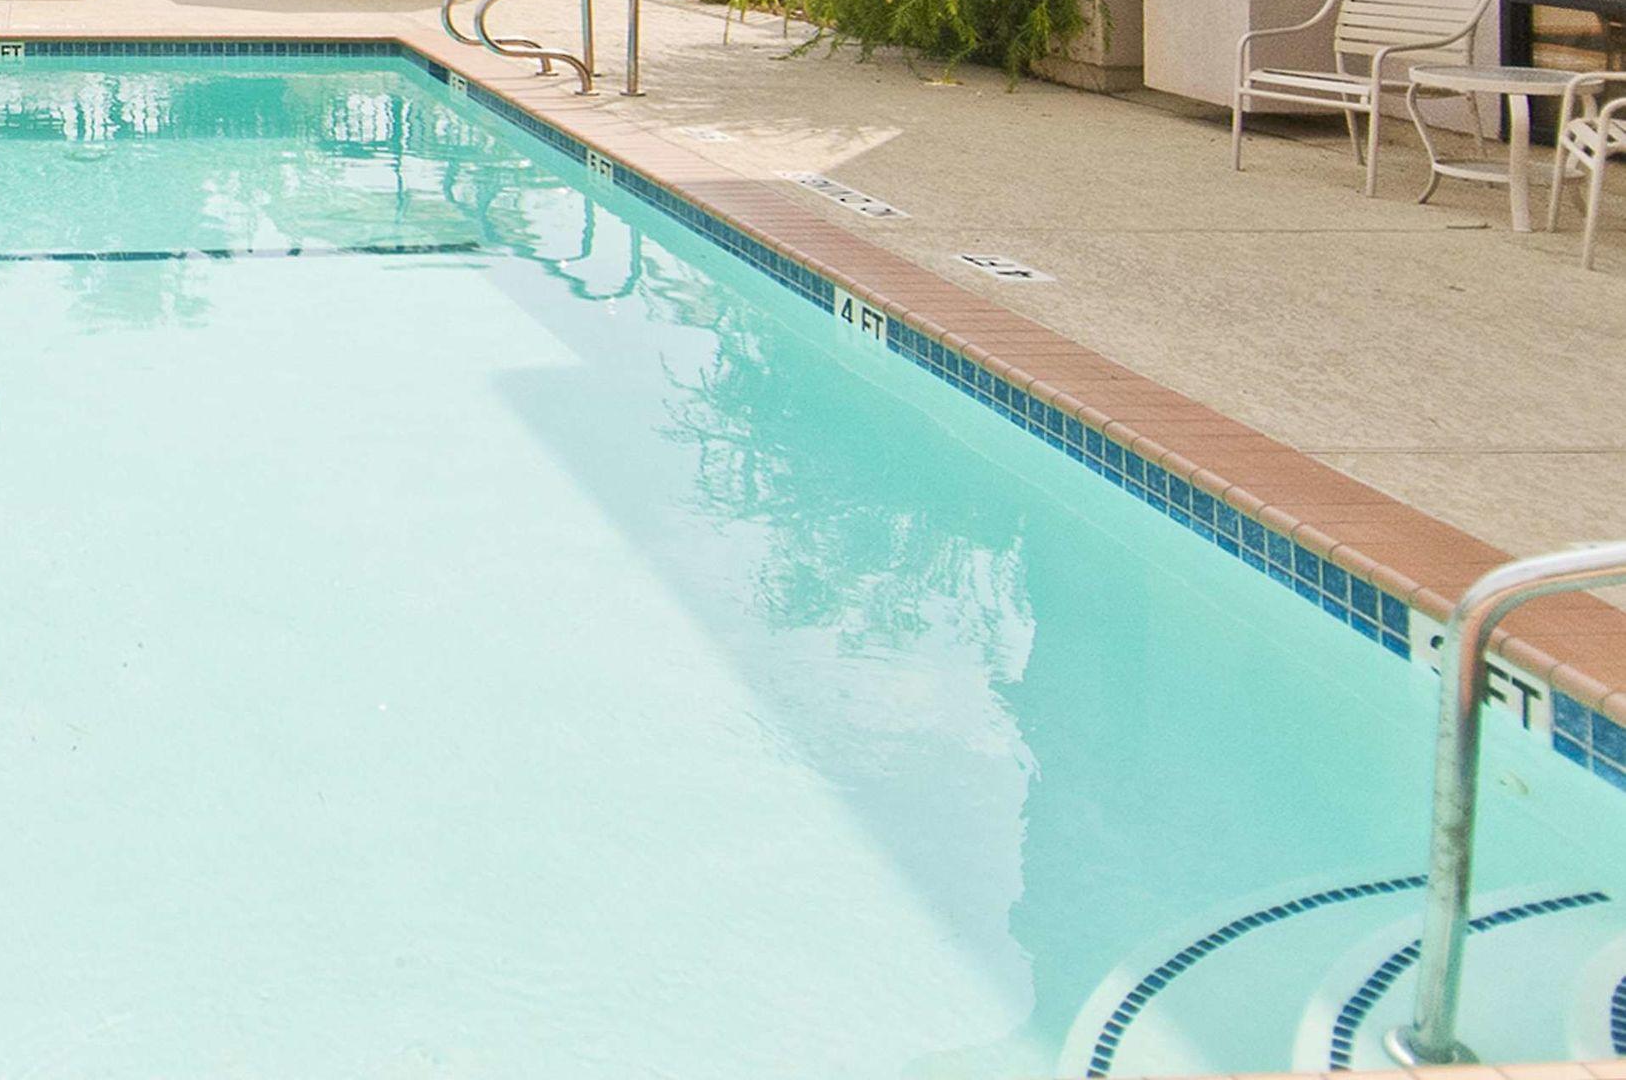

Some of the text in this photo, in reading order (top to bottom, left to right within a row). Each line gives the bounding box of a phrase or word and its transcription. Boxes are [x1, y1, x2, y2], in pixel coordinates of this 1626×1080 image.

[1, 45, 22, 57] FT
[841, 298, 884, 340] 4 FT
[1484, 661, 1542, 731] FT
